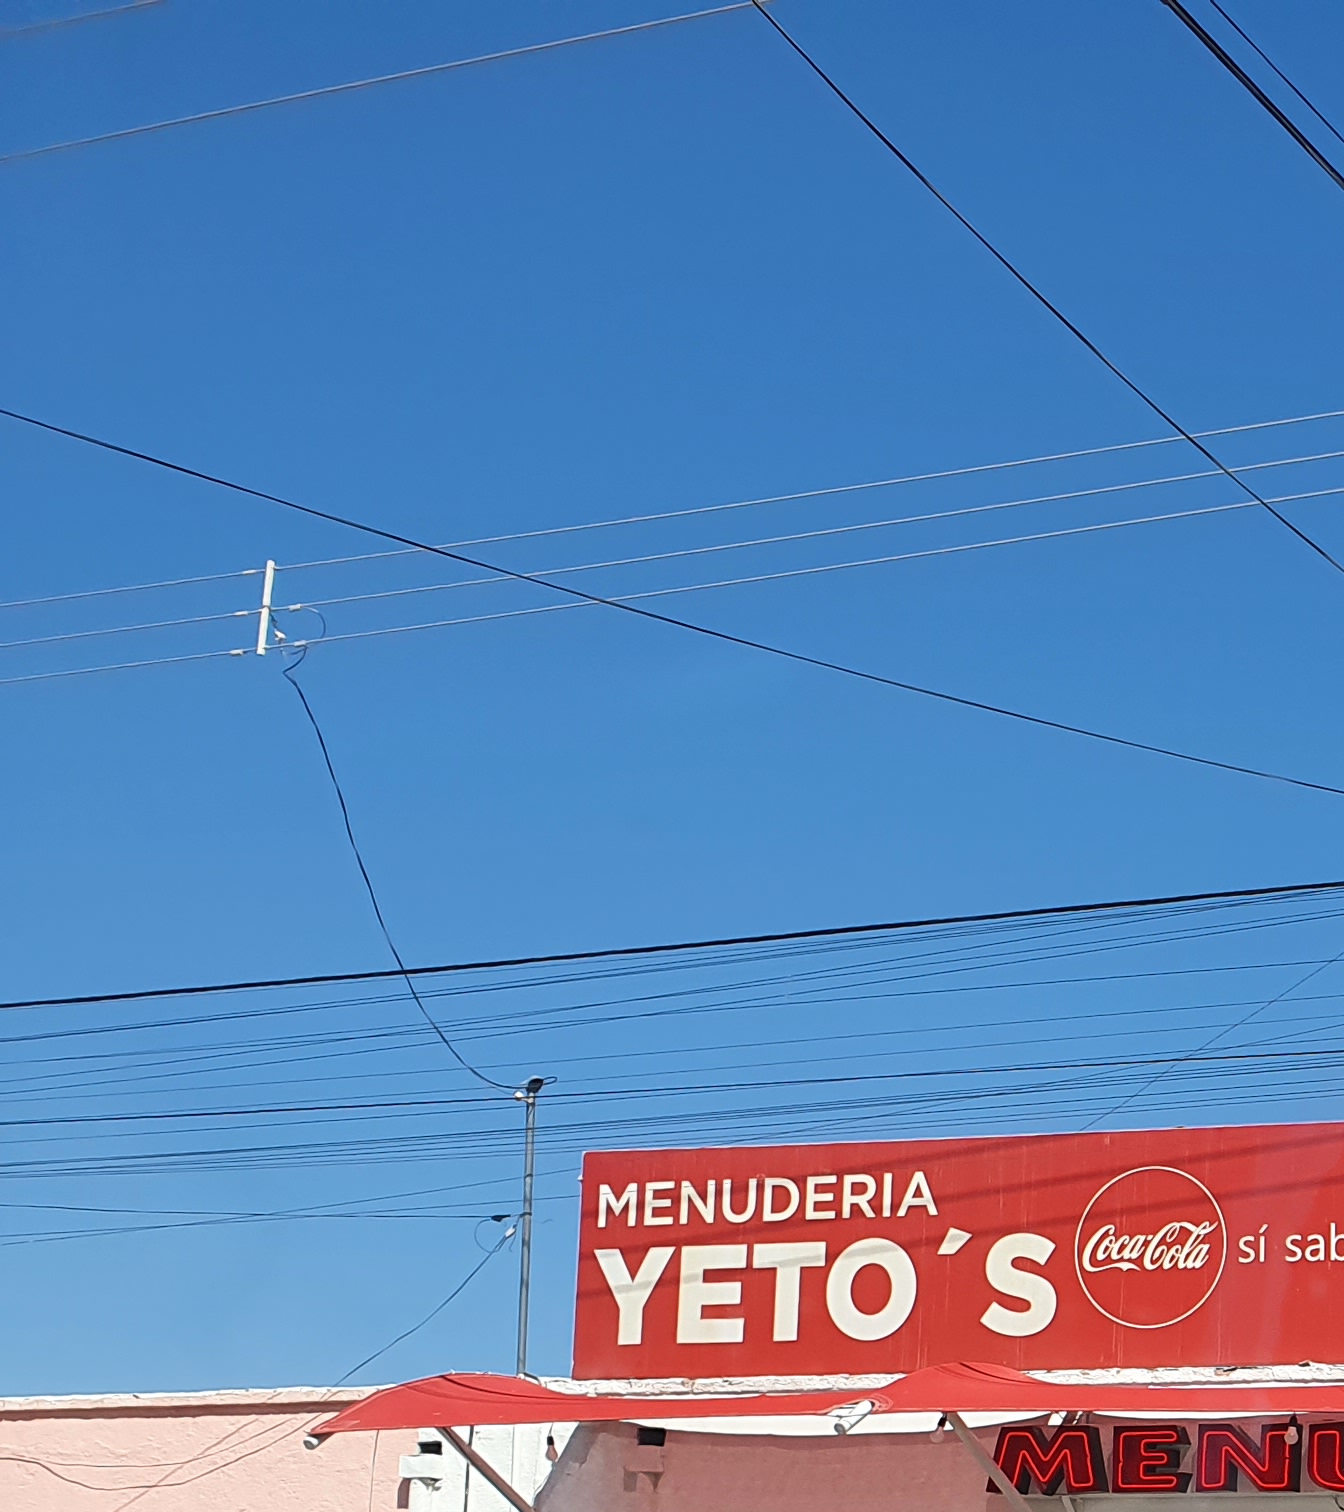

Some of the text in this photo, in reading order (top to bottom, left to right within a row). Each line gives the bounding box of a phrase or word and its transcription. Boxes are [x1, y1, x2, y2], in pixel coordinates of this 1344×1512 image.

[596, 1170, 939, 1229] MENUDERIA
[1081, 1219, 1218, 1272] Coca-Cola
[1237, 1222, 1267, 1264] sí
